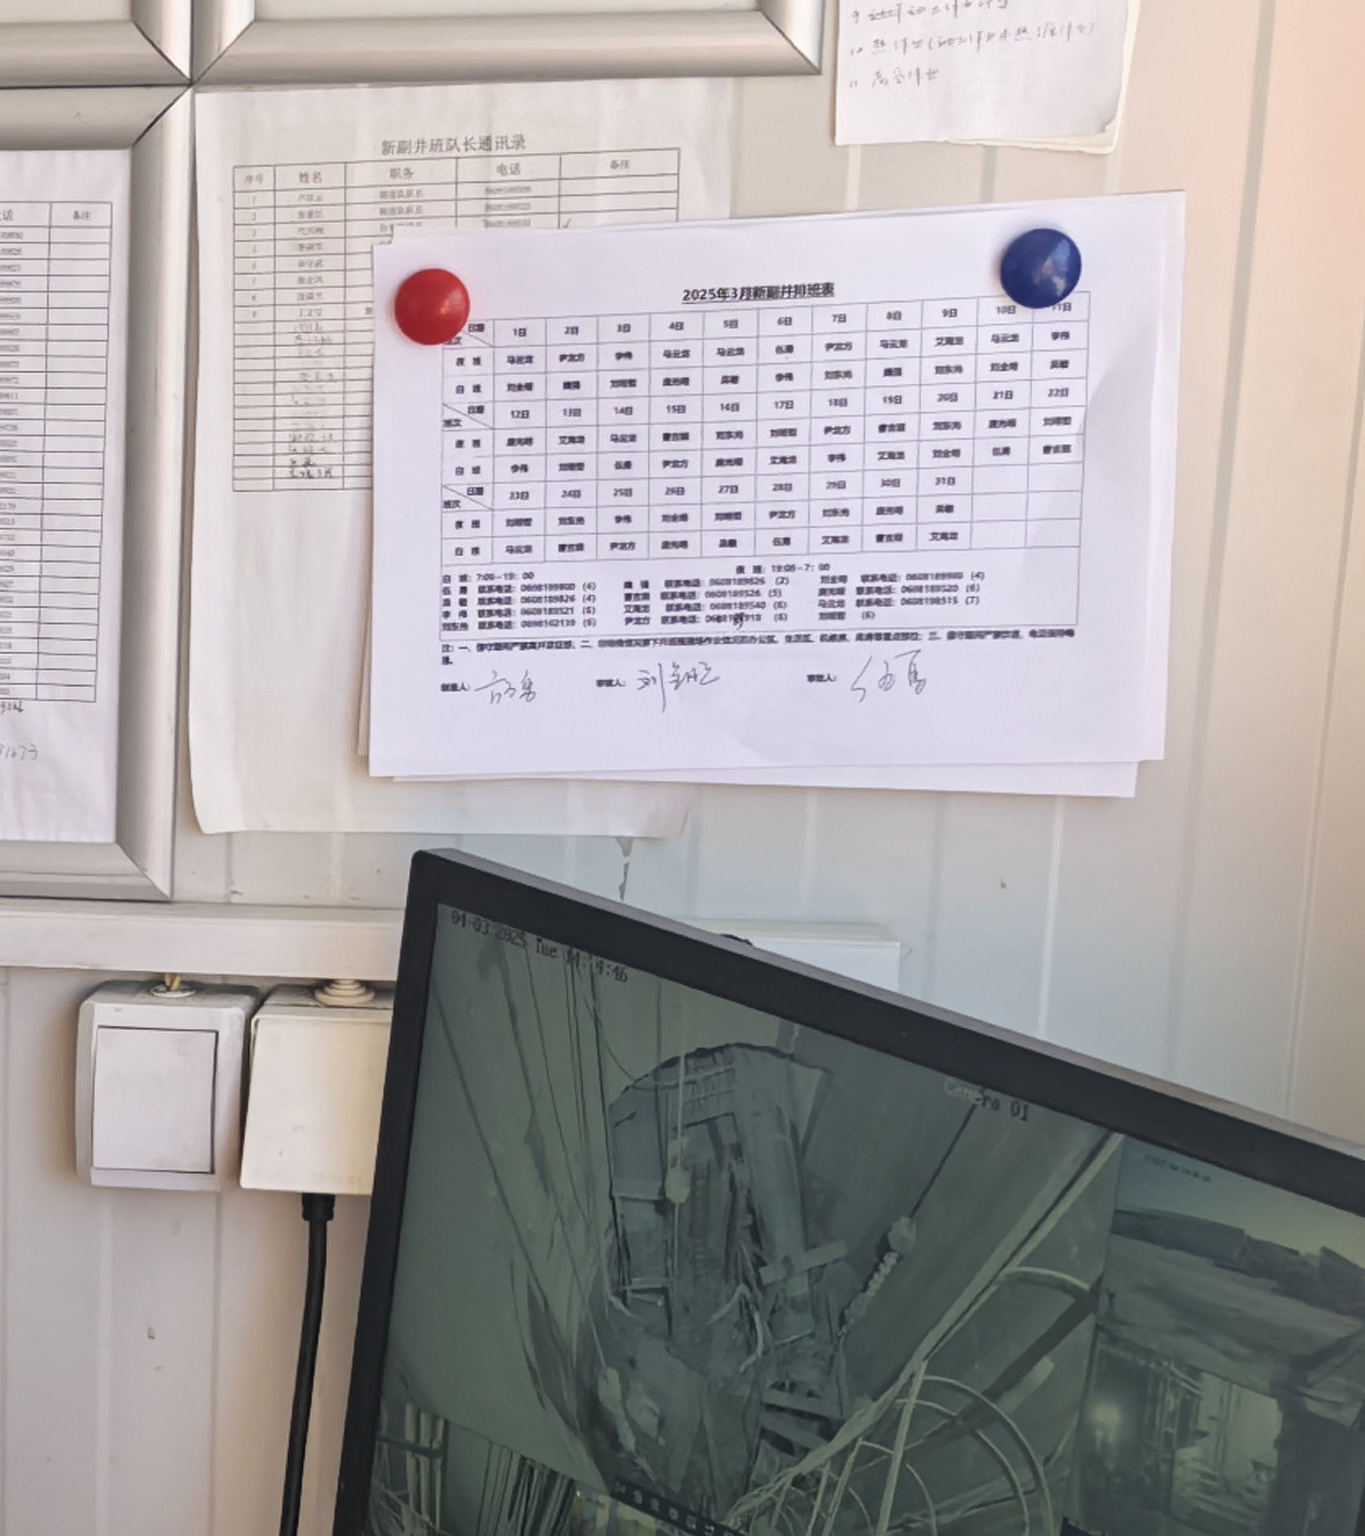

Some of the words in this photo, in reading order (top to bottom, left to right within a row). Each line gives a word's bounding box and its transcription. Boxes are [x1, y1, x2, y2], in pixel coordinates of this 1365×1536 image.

[299, 171, 322, 184] 姓名
[390, 168, 414, 179] 职务
[496, 164, 521, 175] 电话
